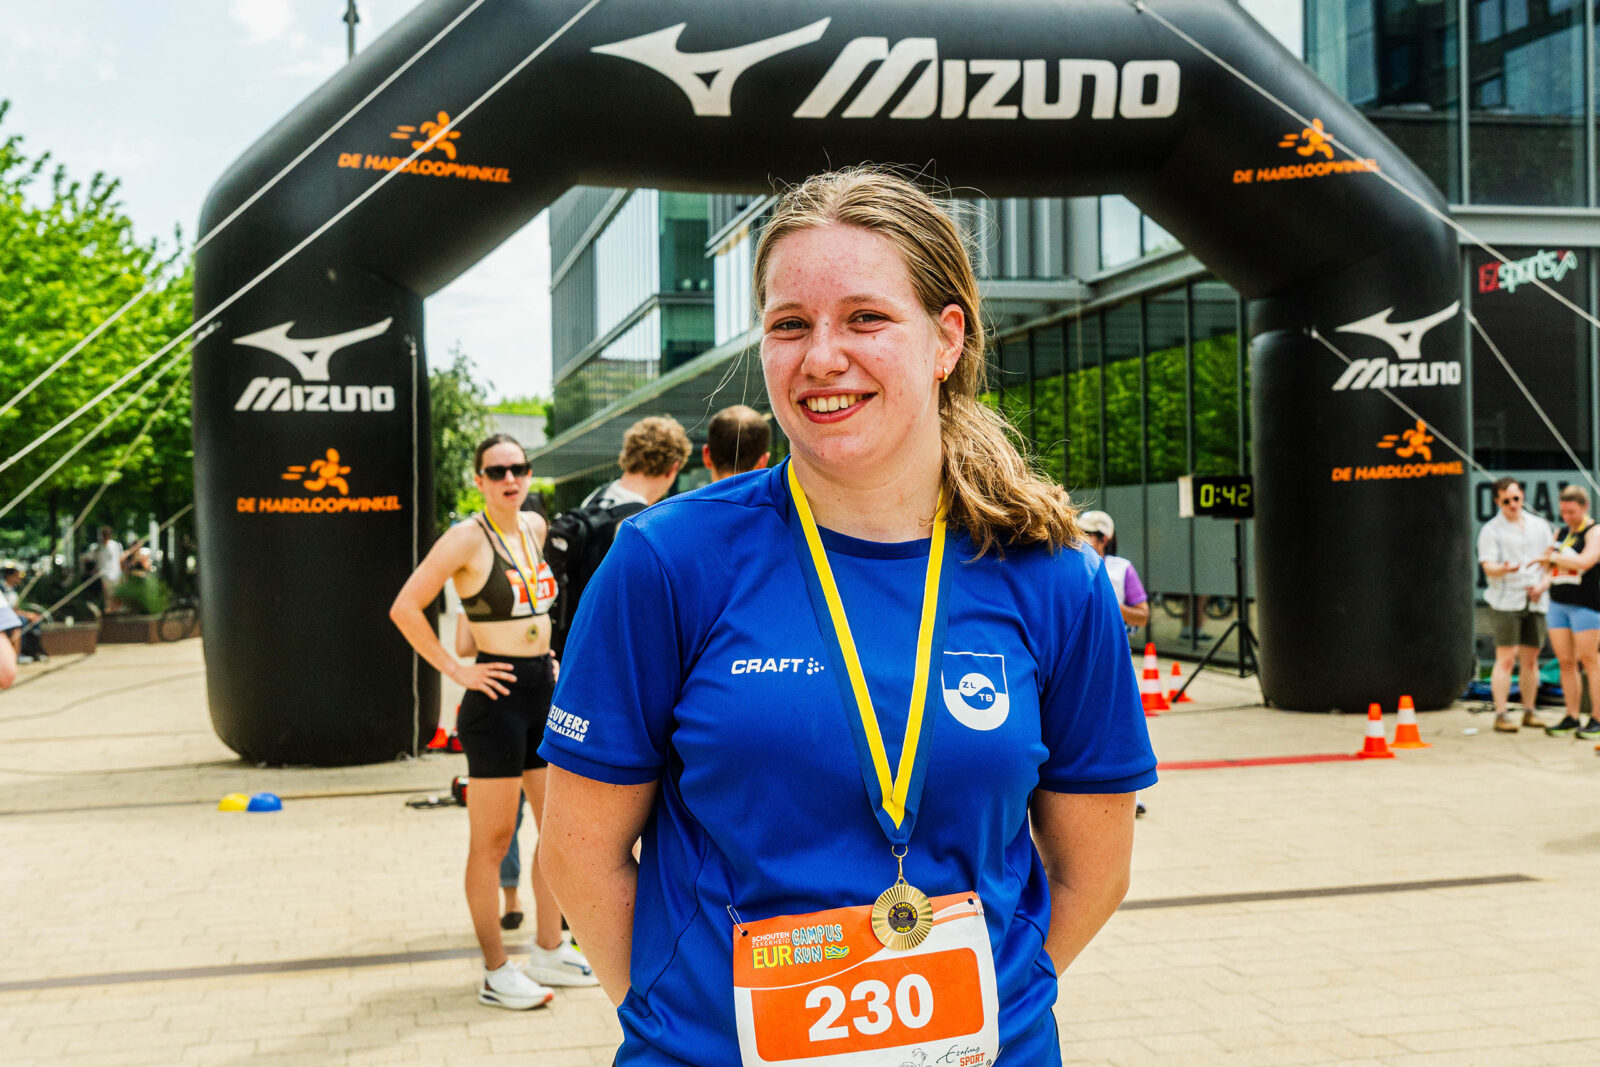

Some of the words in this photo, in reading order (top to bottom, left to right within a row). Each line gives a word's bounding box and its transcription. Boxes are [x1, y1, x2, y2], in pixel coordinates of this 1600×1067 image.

[792, 36, 1181, 120] MIZUNO
[337, 152, 363, 169] DE
[363, 154, 512, 183] HARDLOOPWINKEL
[1233, 169, 1254, 183] DE
[1331, 357, 1461, 391] MIZUNO
[234, 377, 395, 412] MIZUNO
[1331, 467, 1353, 481] DE
[1355, 461, 1464, 480] HARDLOOPWINKEL
[236, 496, 256, 513] DE
[258, 495, 402, 514] HARDLOOPWINKEL
[1200, 483, 1252, 508] 0:42
[731, 658, 805, 675] CRAFT
[961, 681, 977, 690] ZL
[978, 693, 994, 702] TB
[751, 931, 790, 943] SCHOUTEN
[751, 938, 790, 948] ZEKERHEID
[791, 924, 844, 947] CAMPUS
[752, 944, 793, 969] EUR
[794, 945, 823, 965] RUN
[805, 973, 934, 1042] 230
[960, 1052, 986, 1067] SPORT
